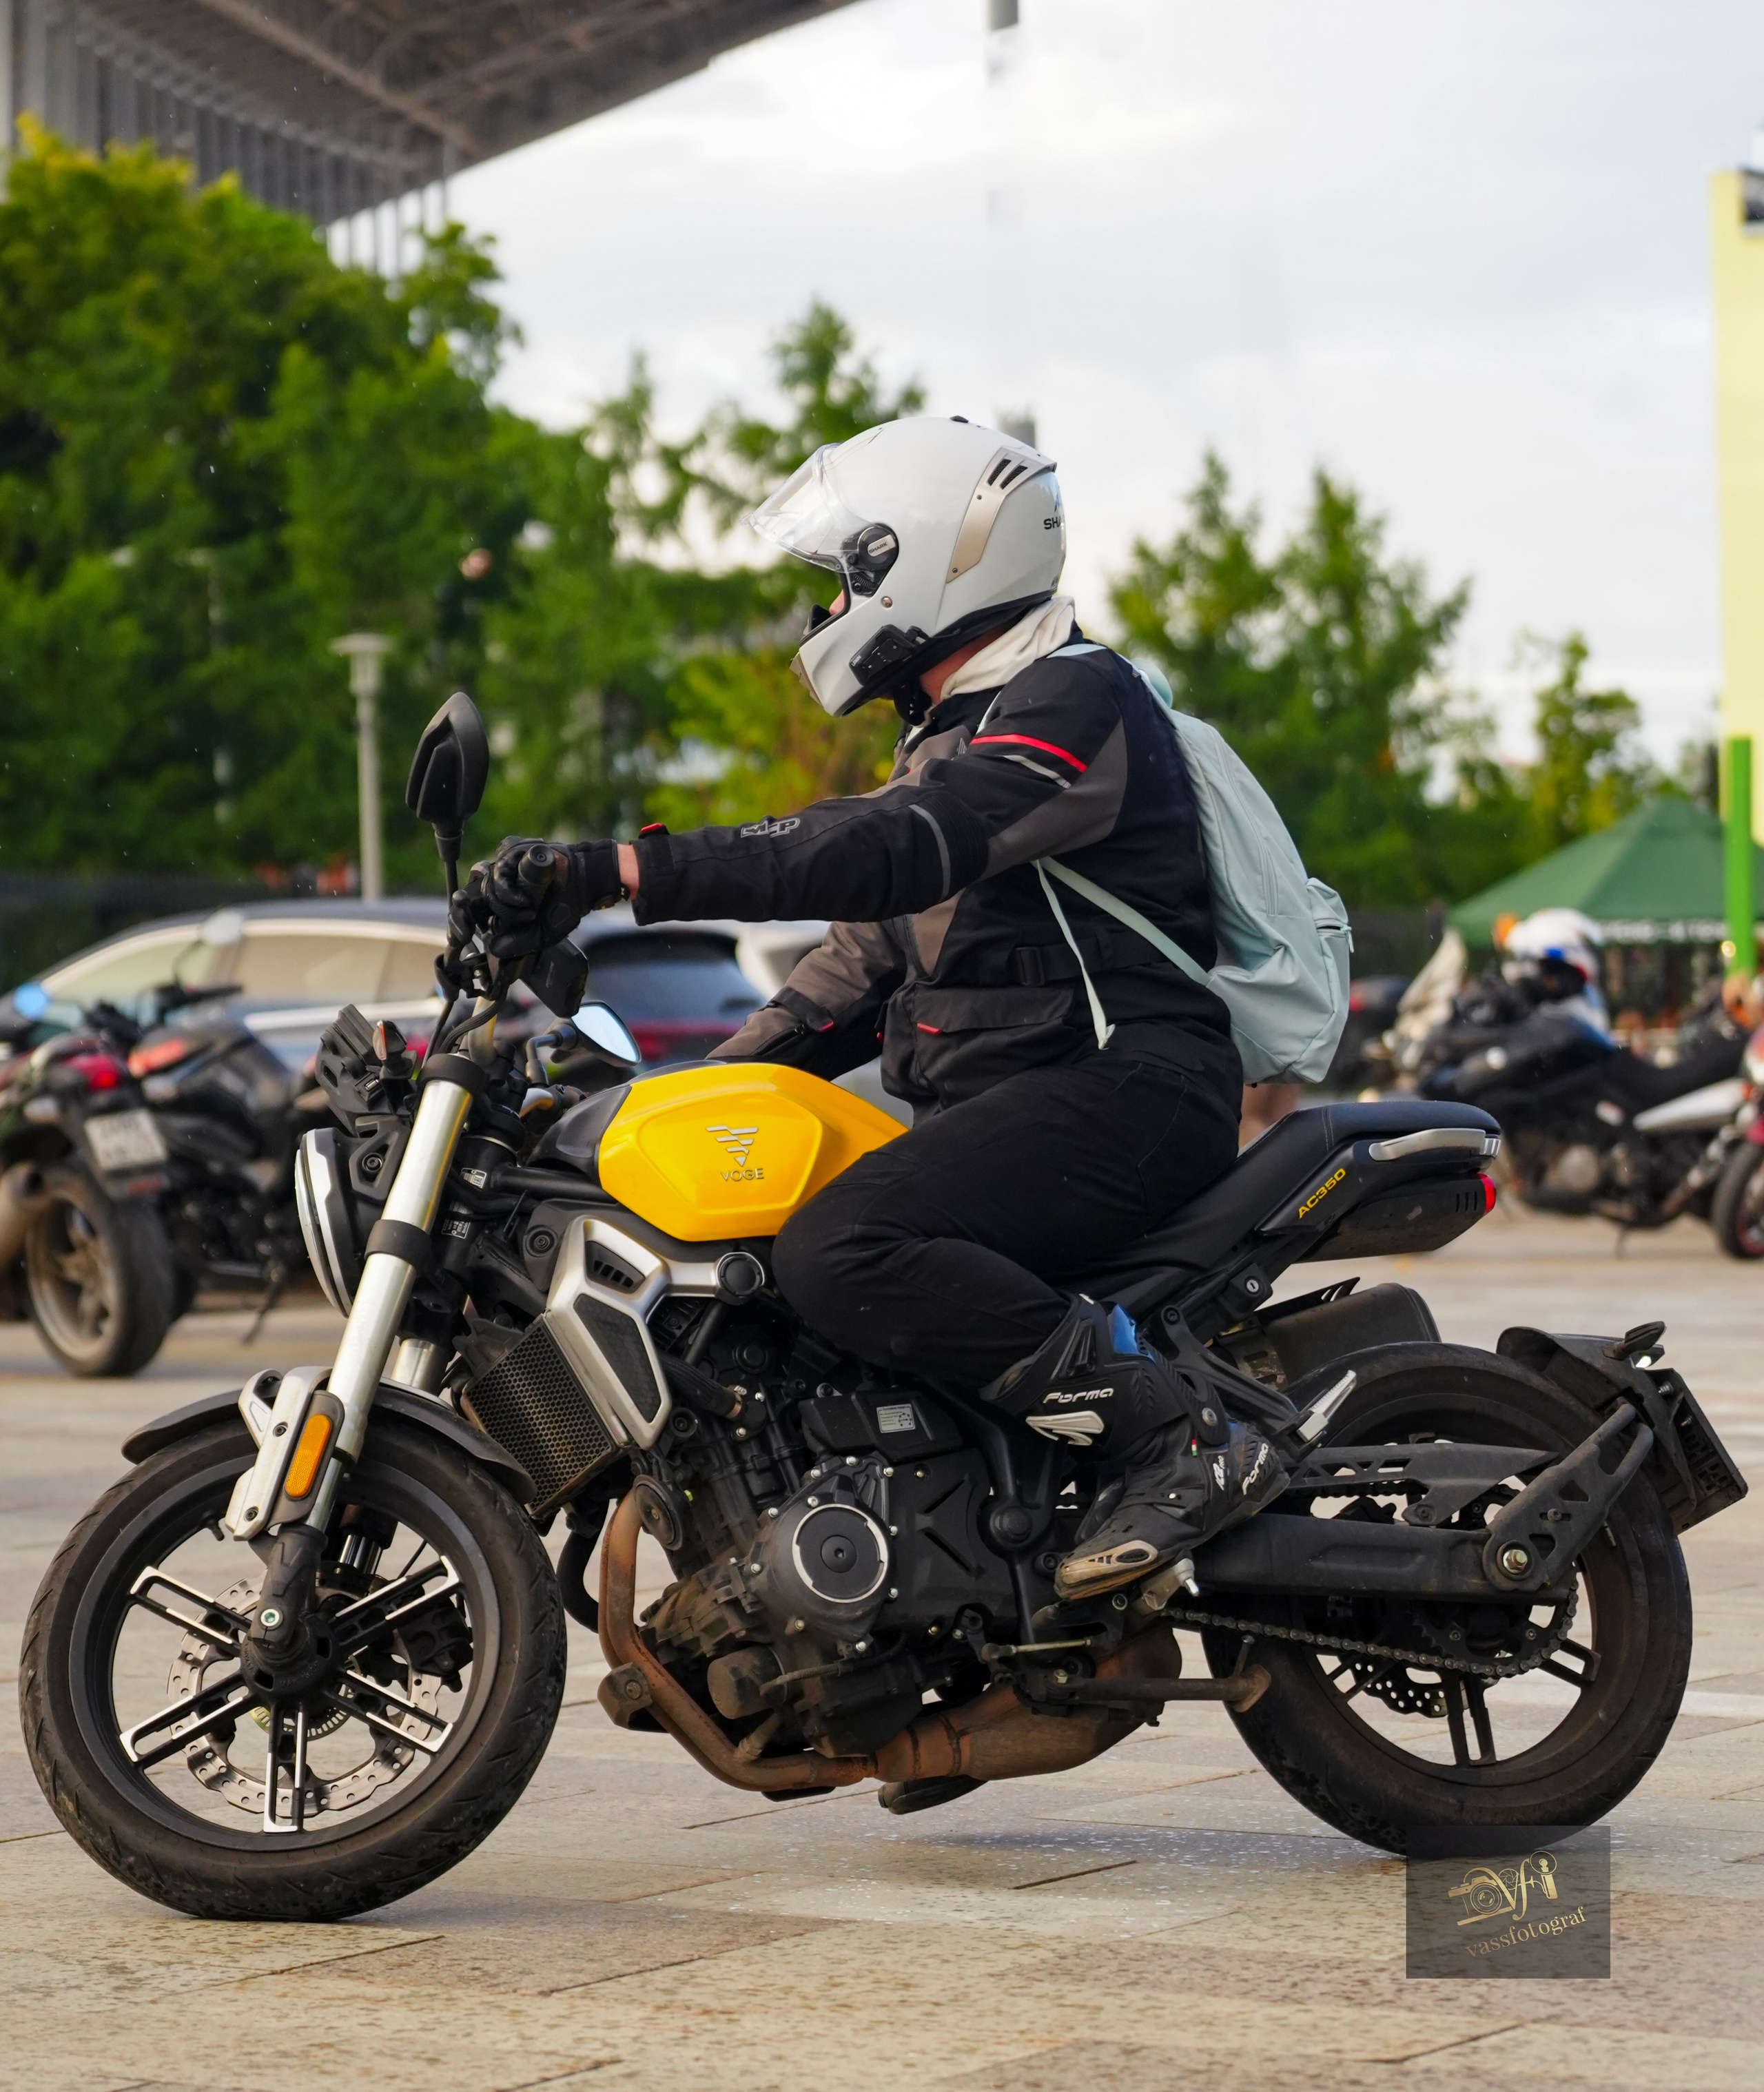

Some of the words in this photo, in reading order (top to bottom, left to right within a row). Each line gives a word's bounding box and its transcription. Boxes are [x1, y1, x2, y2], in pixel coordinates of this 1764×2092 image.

[868, 542, 888, 553] SHARK
[720, 1167, 765, 1182] VOGE
[1298, 1167, 1346, 1219] AC350
